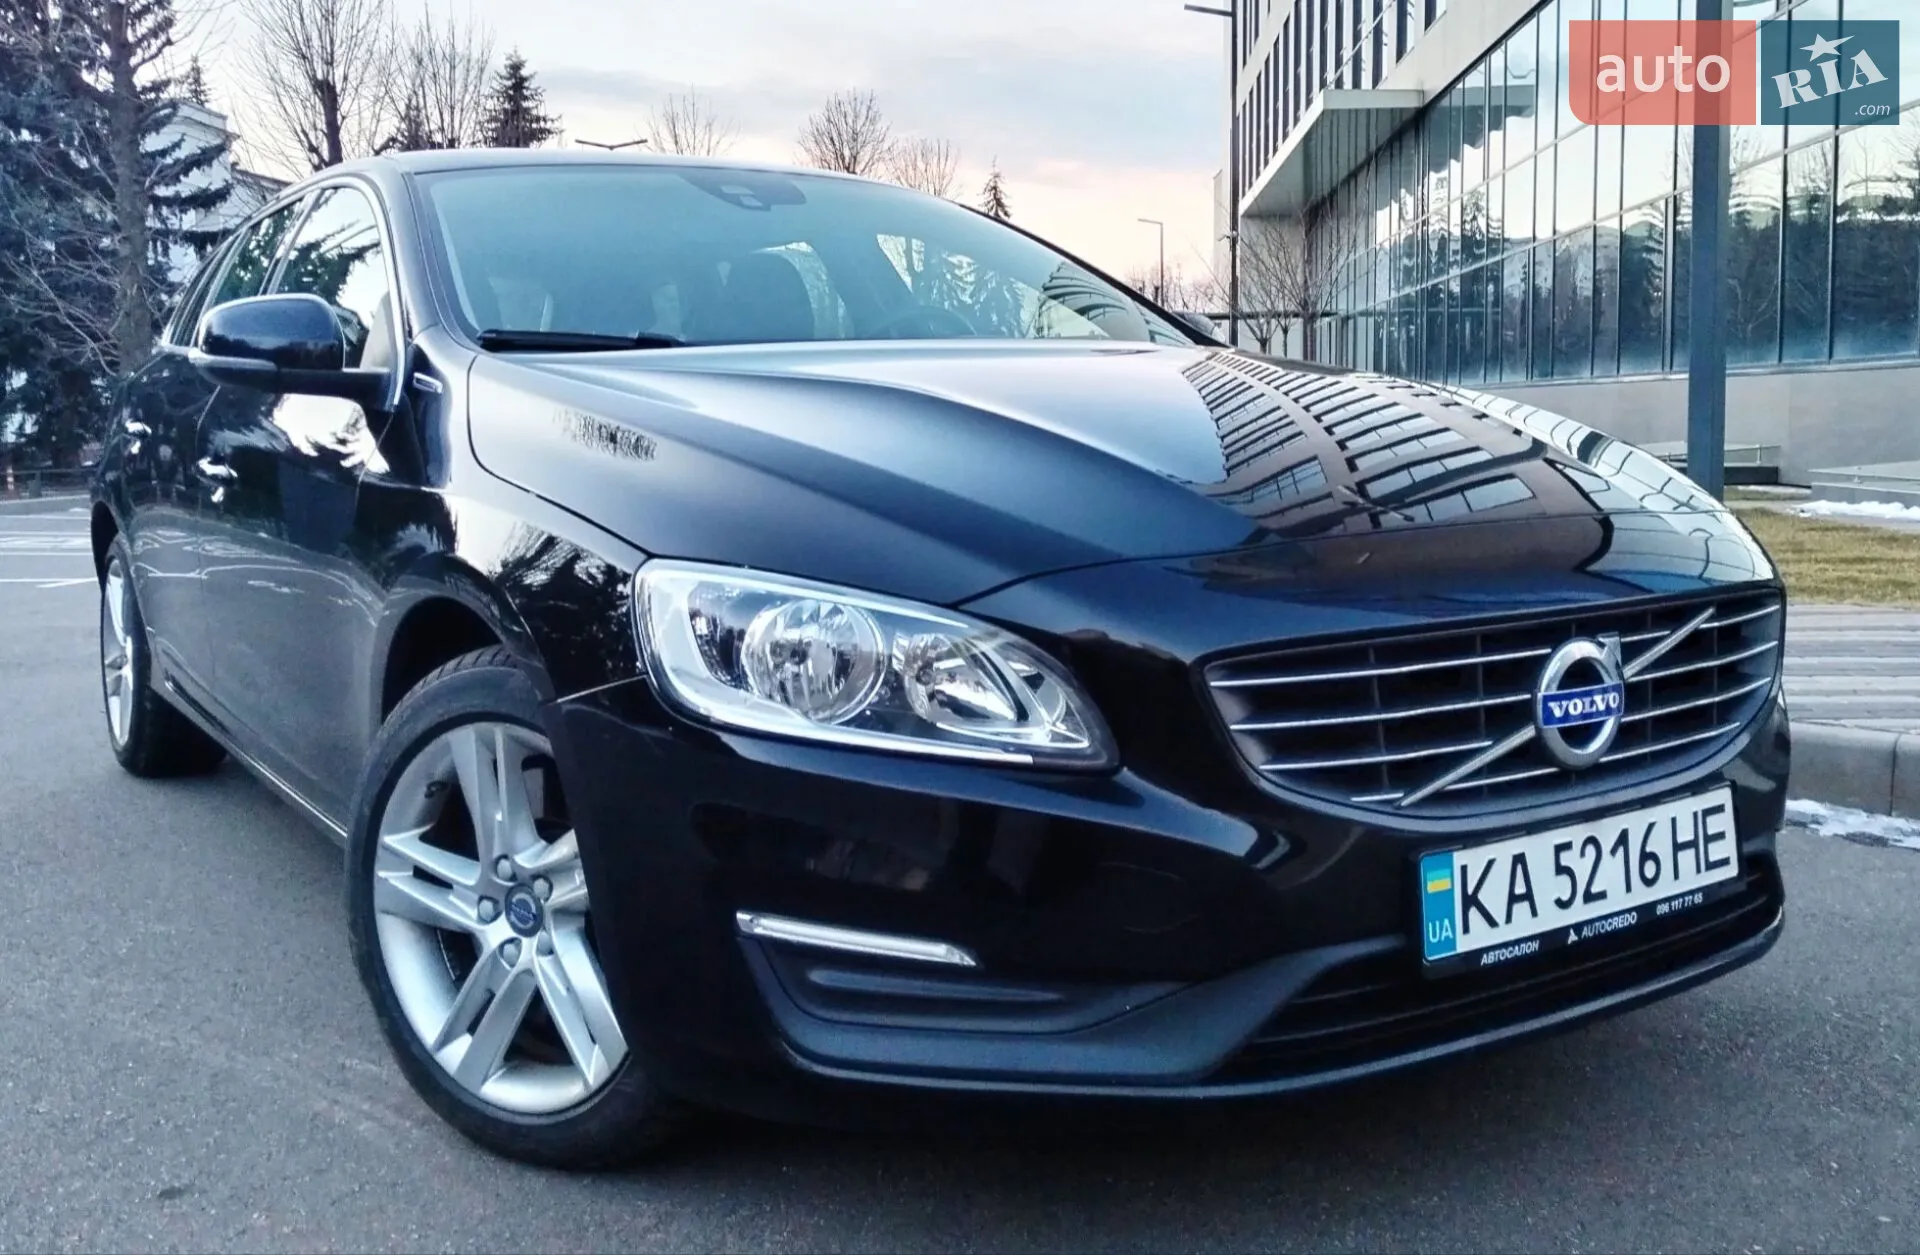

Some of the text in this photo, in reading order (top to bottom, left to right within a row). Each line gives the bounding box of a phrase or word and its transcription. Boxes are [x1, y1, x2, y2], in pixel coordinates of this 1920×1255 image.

[1548, 693, 1619, 718] VOLVO
[1460, 803, 1731, 935] KA 5216 HE
[1428, 918, 1453, 943] UA
[1581, 911, 1638, 938] AUTOCREDO
[1480, 940, 1539, 966] АВТОСАЛОН
